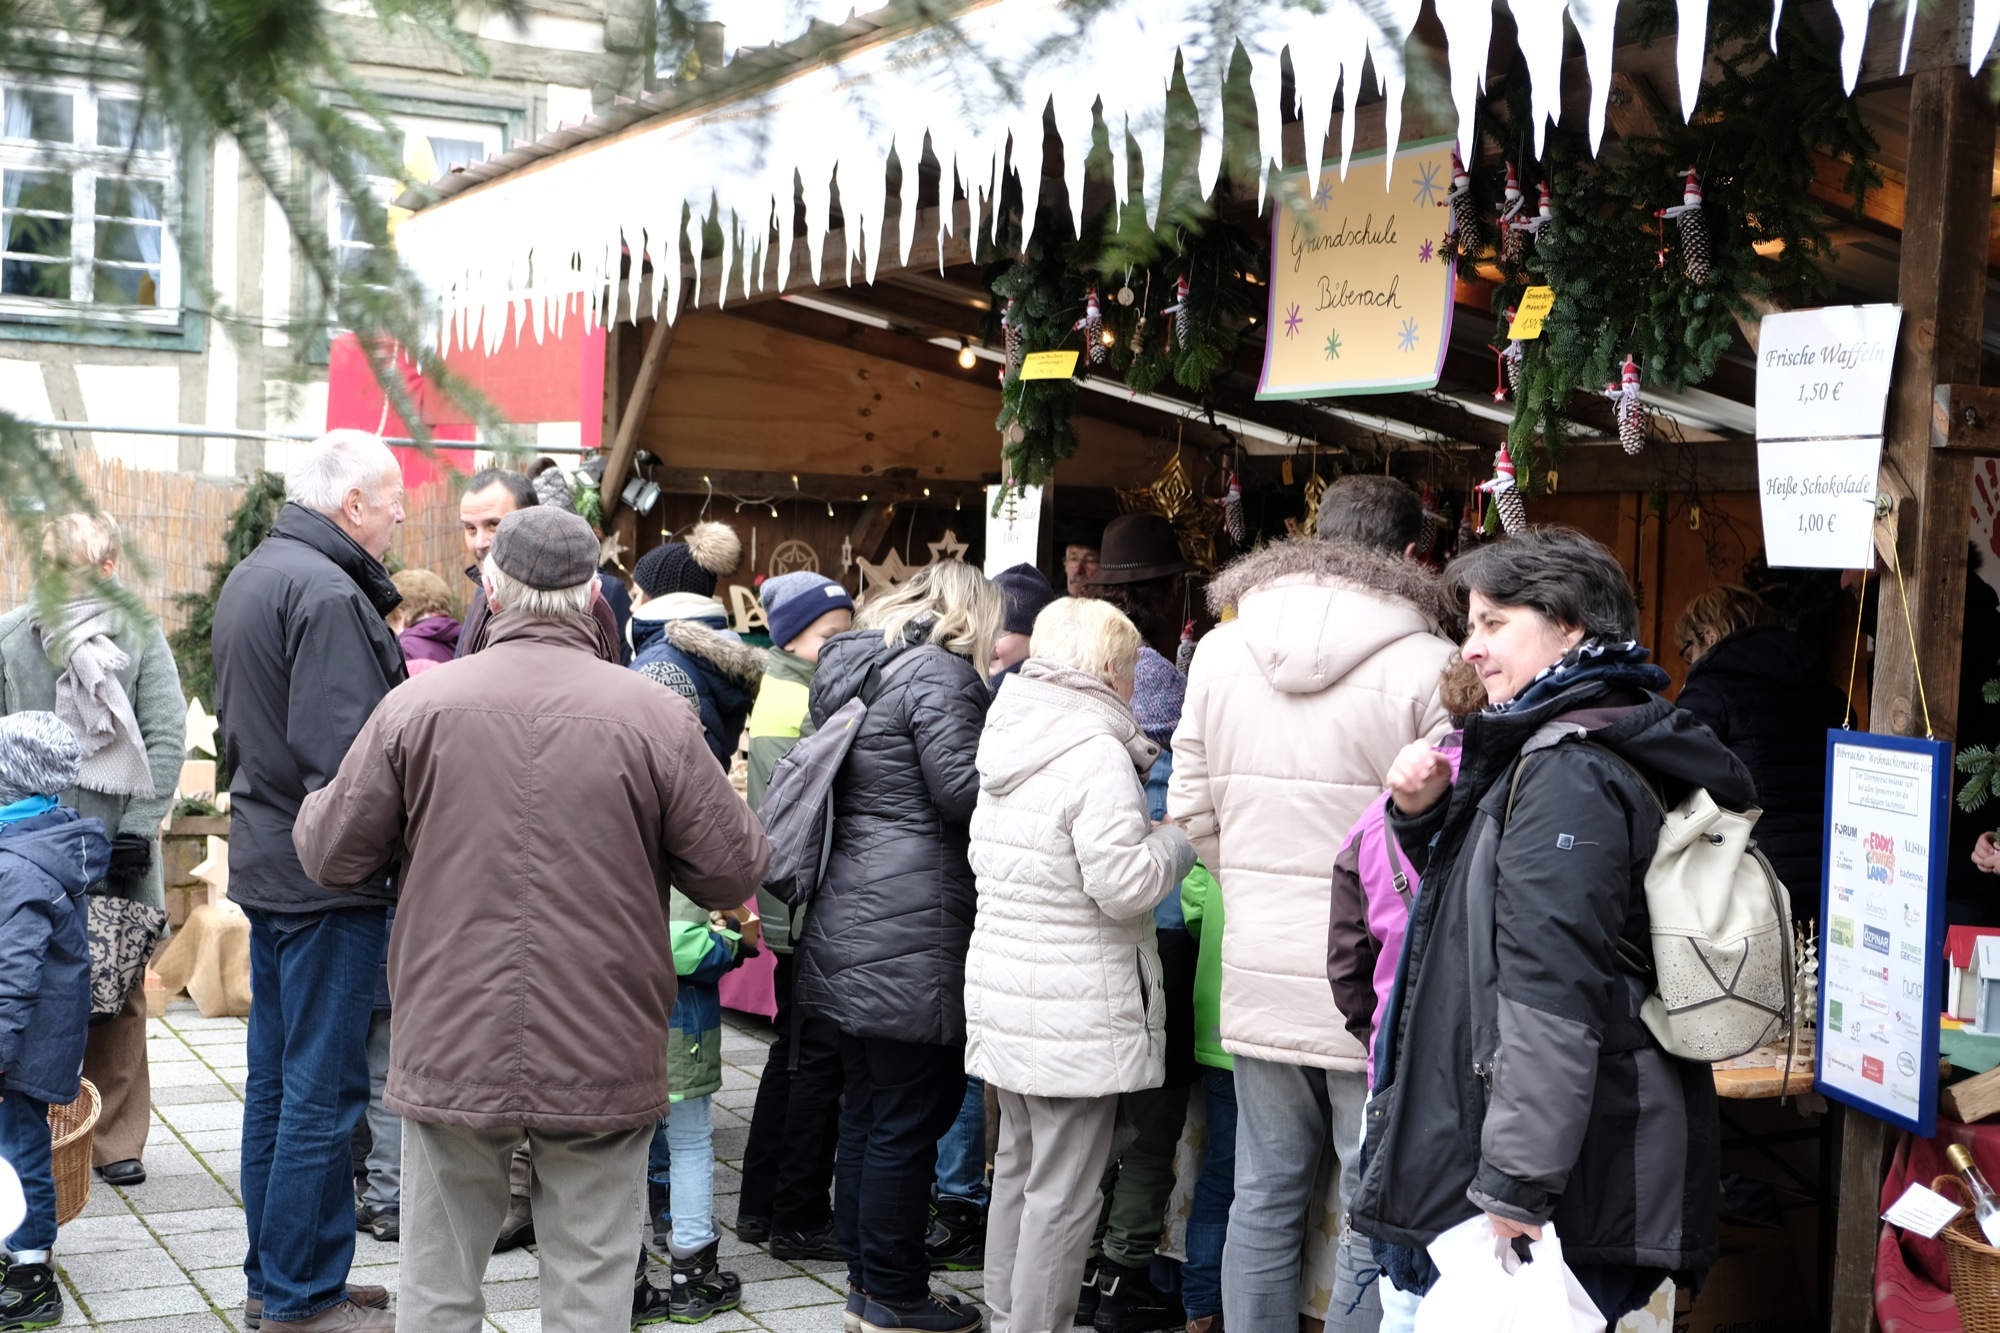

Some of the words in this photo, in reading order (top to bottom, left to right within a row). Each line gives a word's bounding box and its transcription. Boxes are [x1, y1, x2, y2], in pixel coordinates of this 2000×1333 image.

[1291, 214, 1397, 272] Grundschule
[1315, 274, 1402, 311] Biberach
[1765, 345, 1815, 368] Frische
[1820, 342, 1885, 370] Waffeln
[1797, 382, 1828, 405] 1,50
[1832, 381, 1843, 401] €
[1766, 476, 1798, 501] Heiße
[1800, 474, 1870, 499] Schokolade
[1798, 514, 1824, 535] 1,00
[1827, 514, 1837, 533] €
[1836, 746, 1866, 762] Biberacher
[1868, 752, 1919, 772] Weihnachtsmarkt
[1899, 868, 1924, 883] badenova
